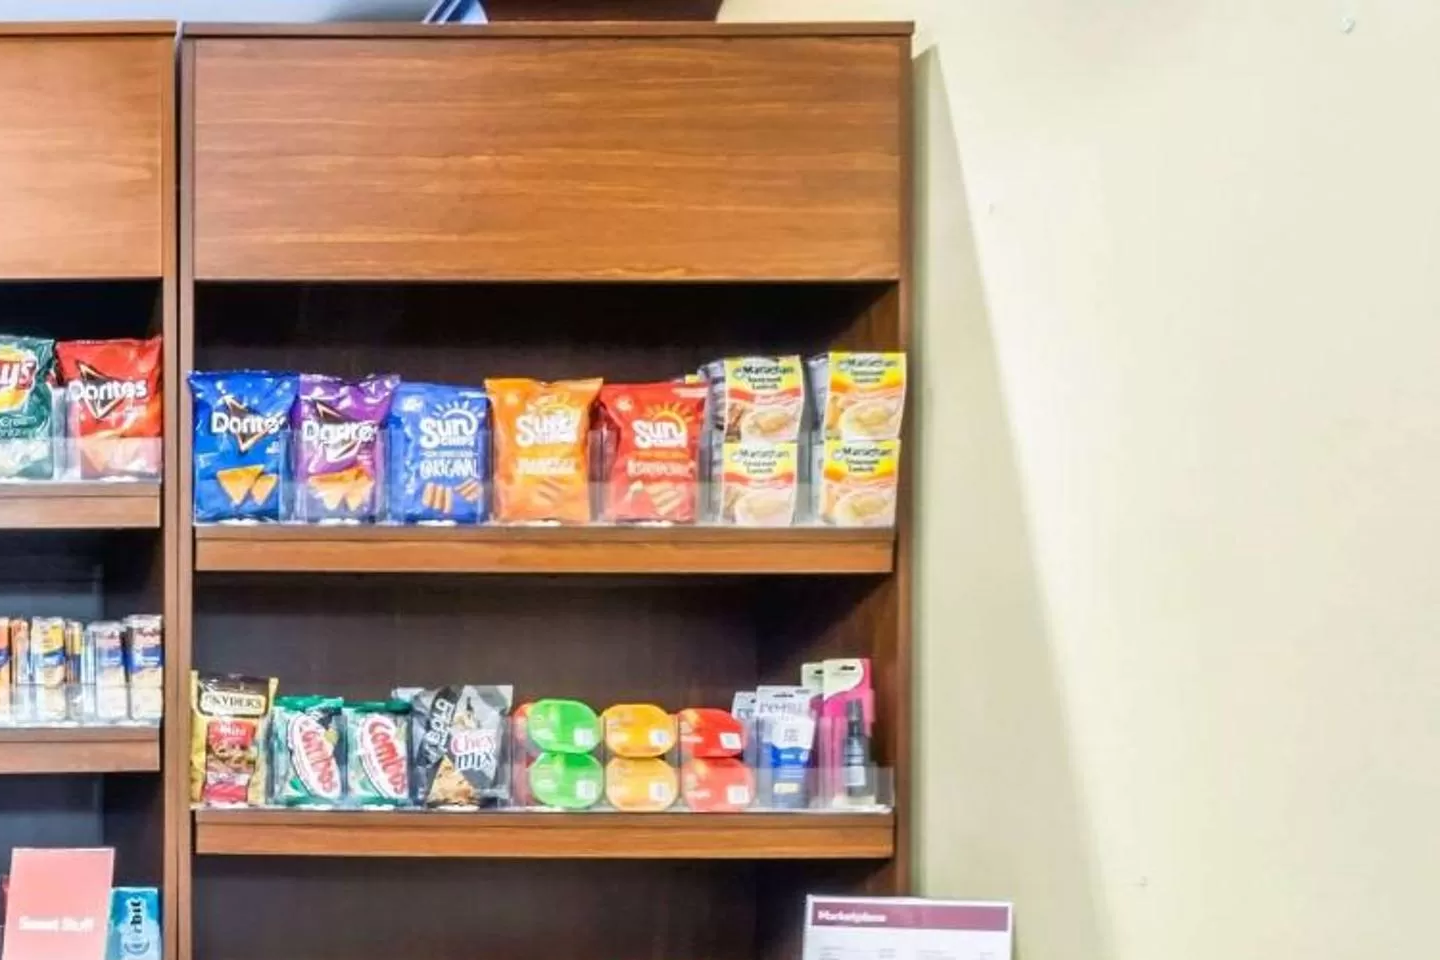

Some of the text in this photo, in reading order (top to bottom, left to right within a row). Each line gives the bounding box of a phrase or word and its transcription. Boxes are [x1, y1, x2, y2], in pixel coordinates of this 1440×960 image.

[68, 377, 149, 401] Doritos
[211, 410, 287, 434] Doritos
[817, 909, 888, 924] Marketplace
